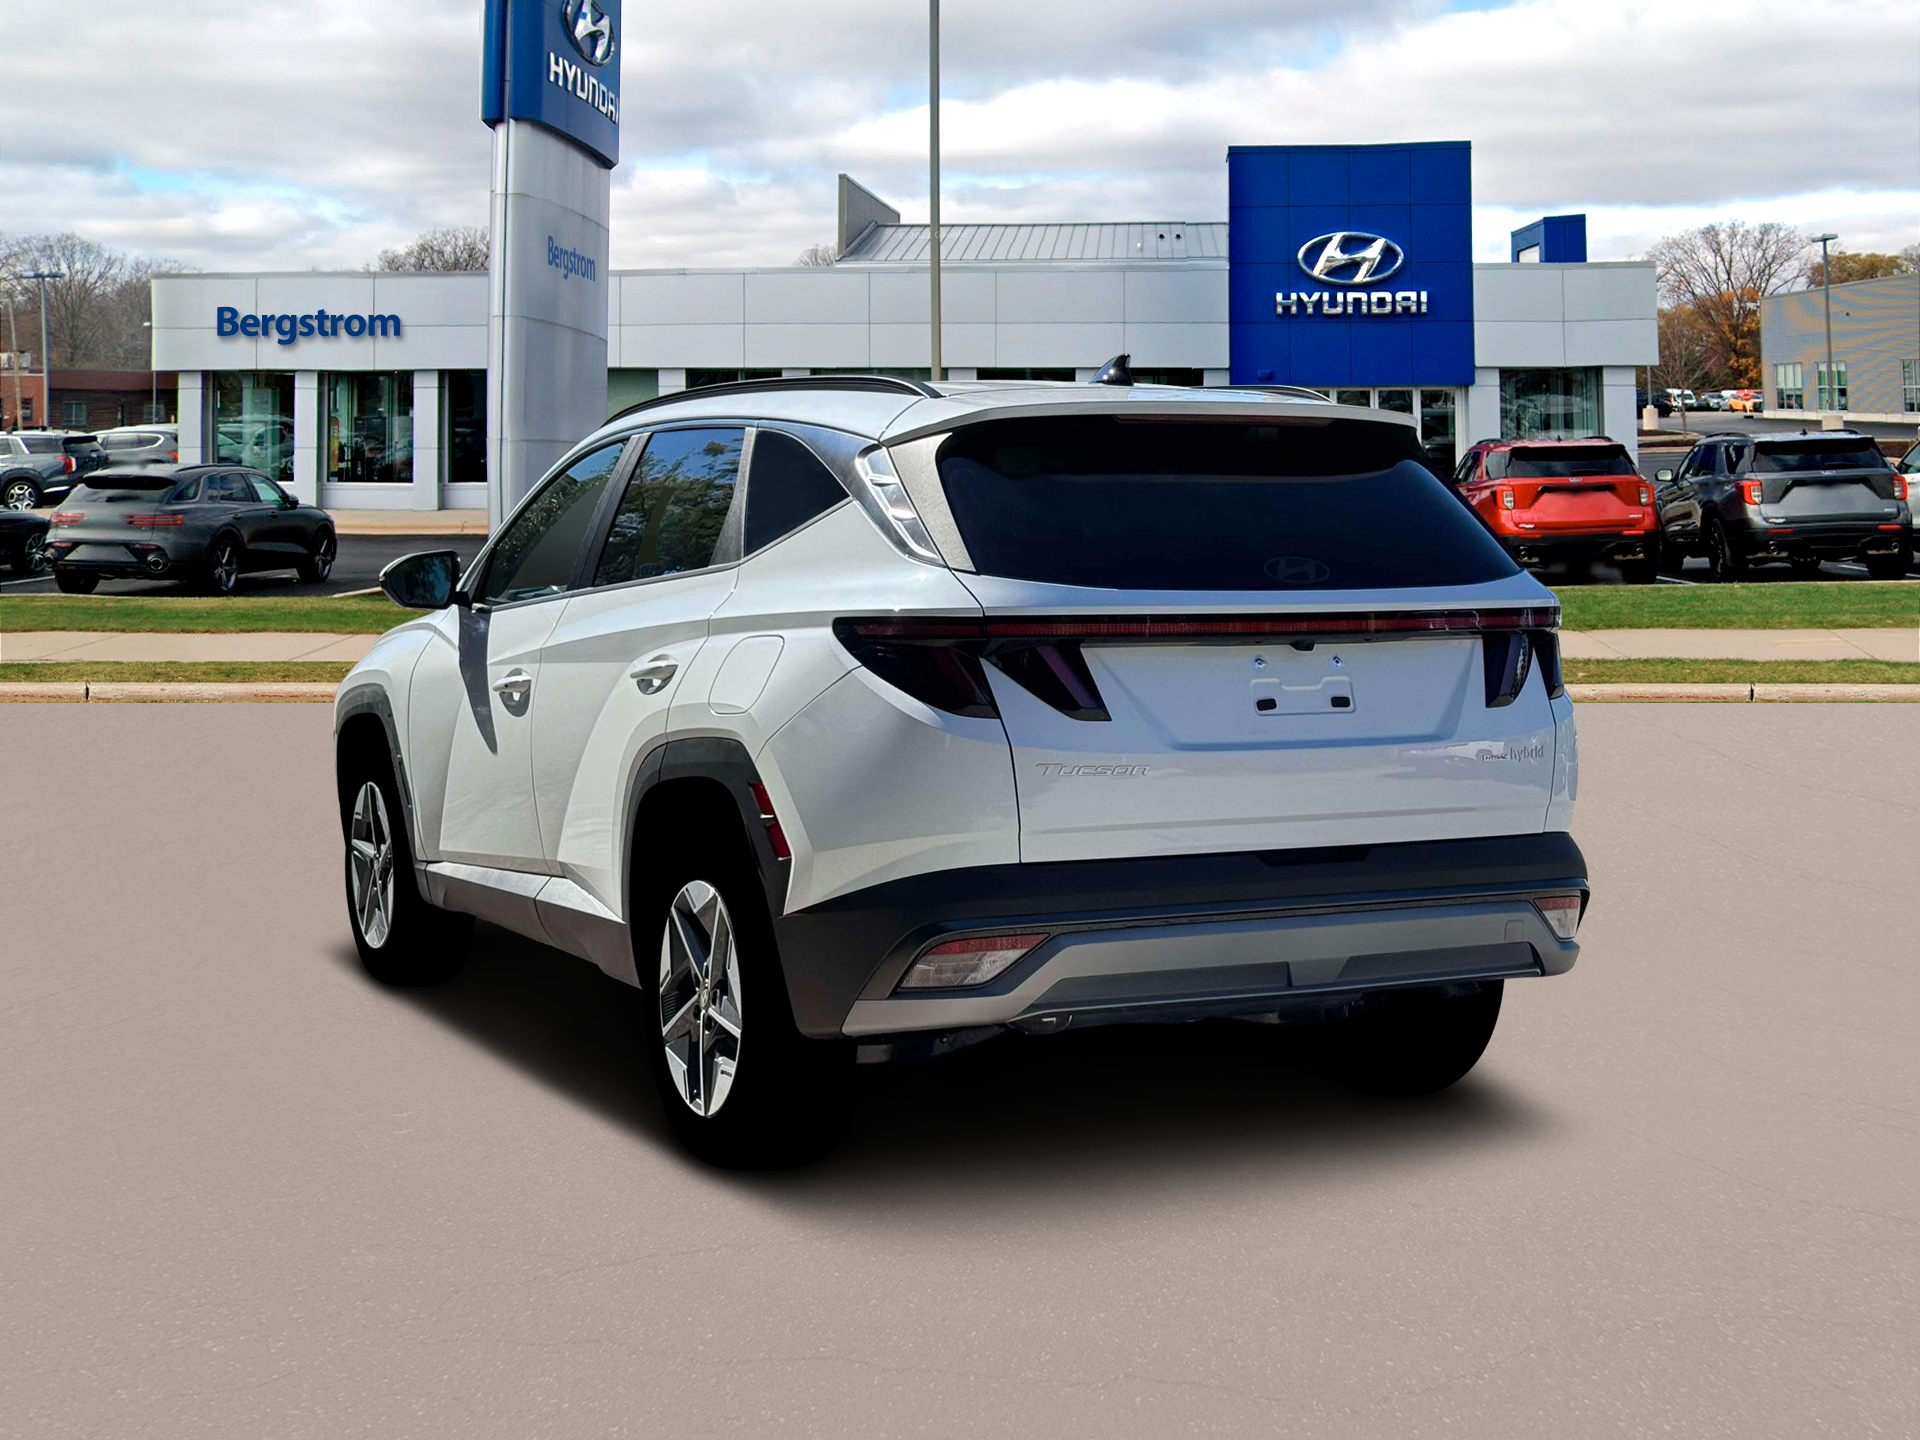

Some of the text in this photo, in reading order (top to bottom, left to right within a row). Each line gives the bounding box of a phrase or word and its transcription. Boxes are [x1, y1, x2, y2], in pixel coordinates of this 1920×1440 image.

[549, 51, 619, 124] HYUNDAI
[547, 235, 596, 282] Bergstrom
[1275, 291, 1428, 315] HYUNDAI
[216, 306, 402, 346] Bergstrom
[1510, 745, 1544, 762] hybrid
